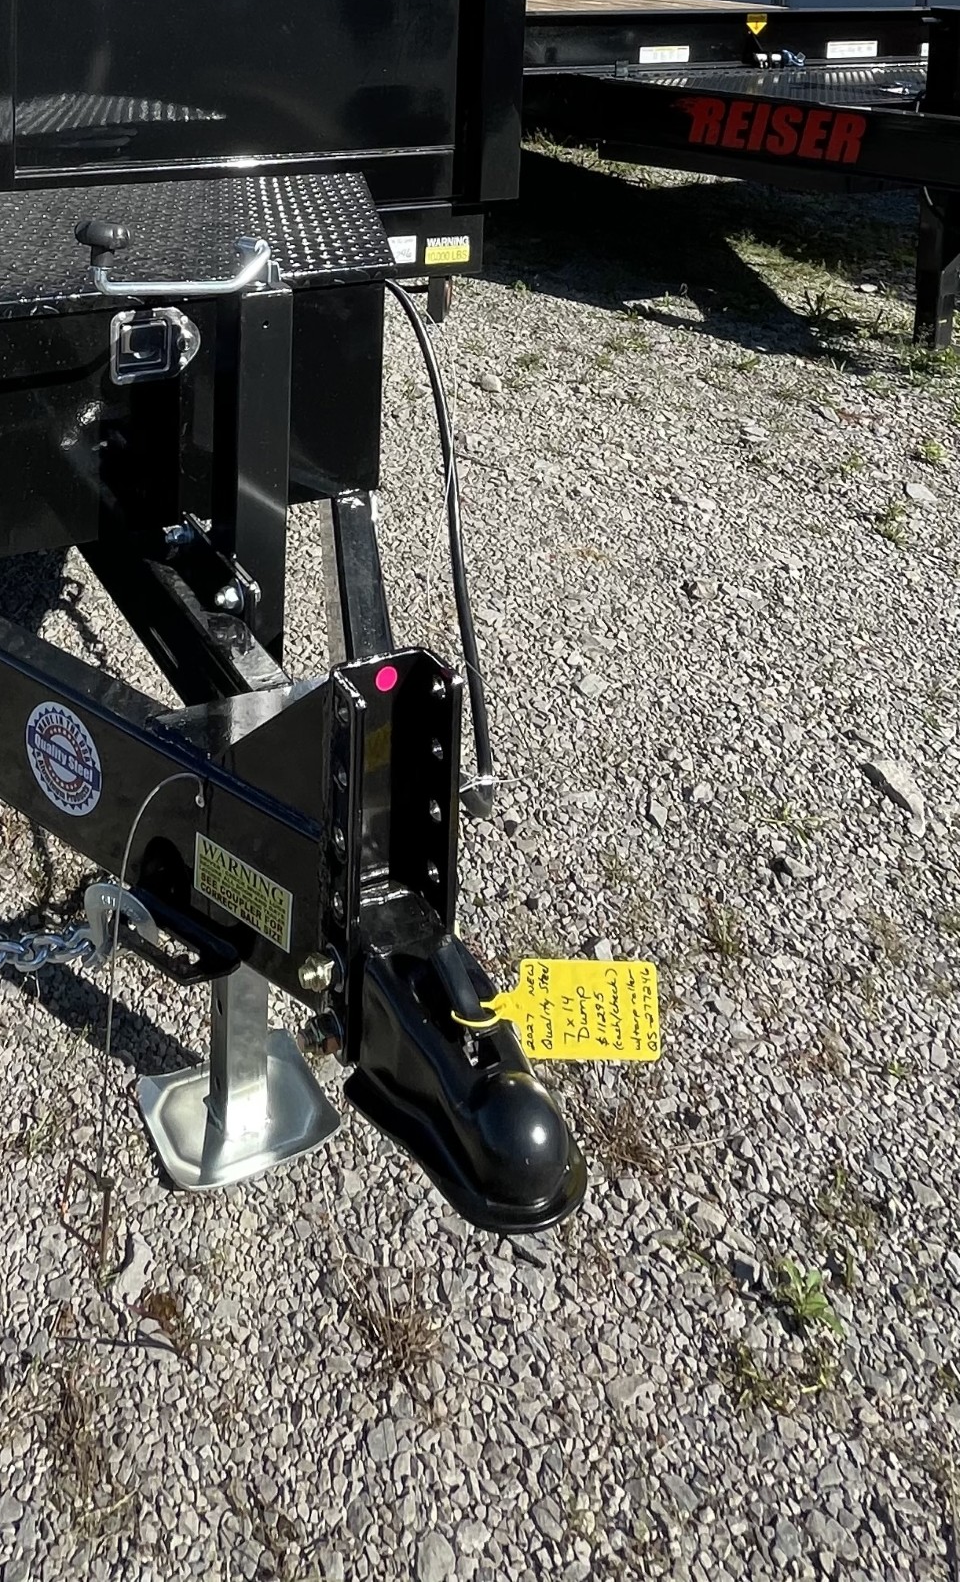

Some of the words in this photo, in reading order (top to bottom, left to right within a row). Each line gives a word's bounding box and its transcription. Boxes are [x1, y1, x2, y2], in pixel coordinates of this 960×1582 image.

[686, 97, 866, 164] REISER
[426, 236, 470, 247] WARNING
[451, 250, 468, 261] LBS
[34, 733, 68, 766] Quality
[68, 755, 93, 783] Steel
[201, 839, 284, 906] WARNING
[200, 871, 218, 891] SEE
[220, 885, 262, 921] COUPLER
[264, 914, 284, 935] FOR
[200, 882, 239, 914] CORRECT
[240, 907, 261, 931] BALL
[263, 925, 283, 945] SIZE
[525, 964, 535, 996] NEW
[538, 961, 550, 994] Steel
[540, 998, 555, 1050] Quality
[561, 995, 575, 1012] 14
[576, 985, 592, 1042] Dump
[526, 1013, 535, 1051] 2027
[564, 1032, 576, 1044] 7
